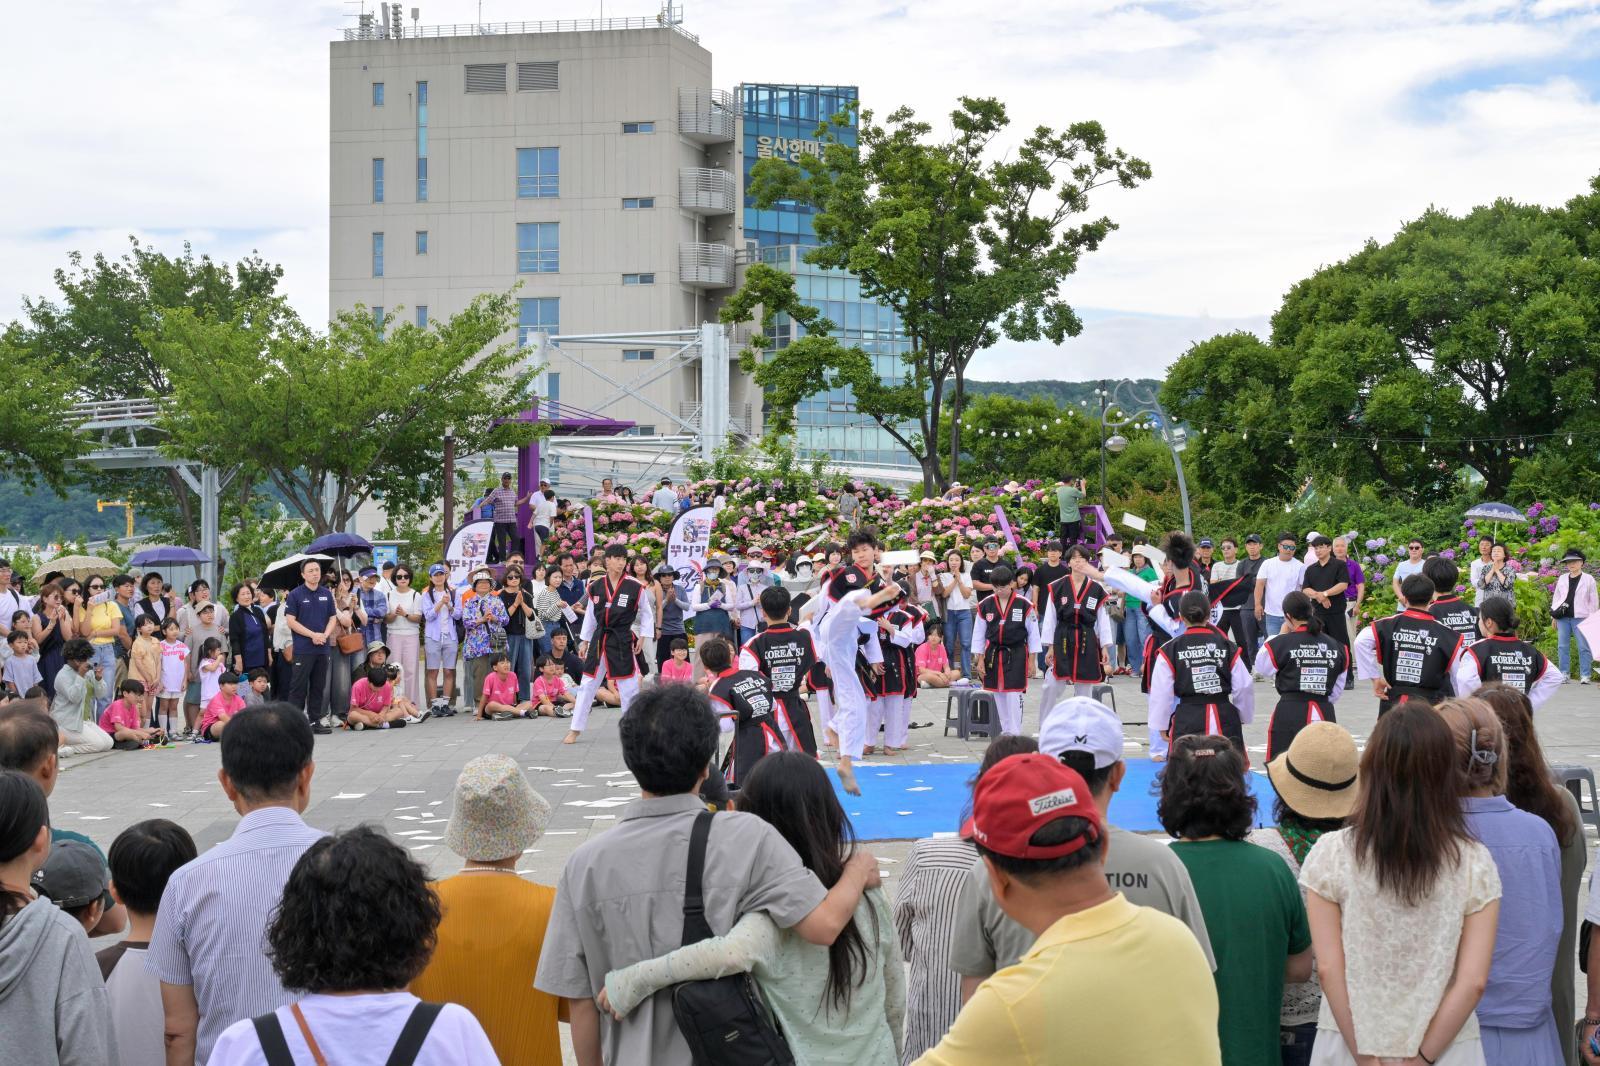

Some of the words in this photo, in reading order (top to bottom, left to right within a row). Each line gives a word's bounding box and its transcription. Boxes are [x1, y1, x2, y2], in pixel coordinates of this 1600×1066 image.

[757, 136, 832, 164] 울산항마
[1424, 636, 1438, 646] SJ
[1178, 648, 1211, 660] KOREA
[1213, 649, 1227, 658] SJ
[1290, 648, 1323, 659] KOREA
[1326, 649, 1338, 659] SJ
[1491, 655, 1520, 665] KOREA
[1033, 793, 1074, 814] Titleist
